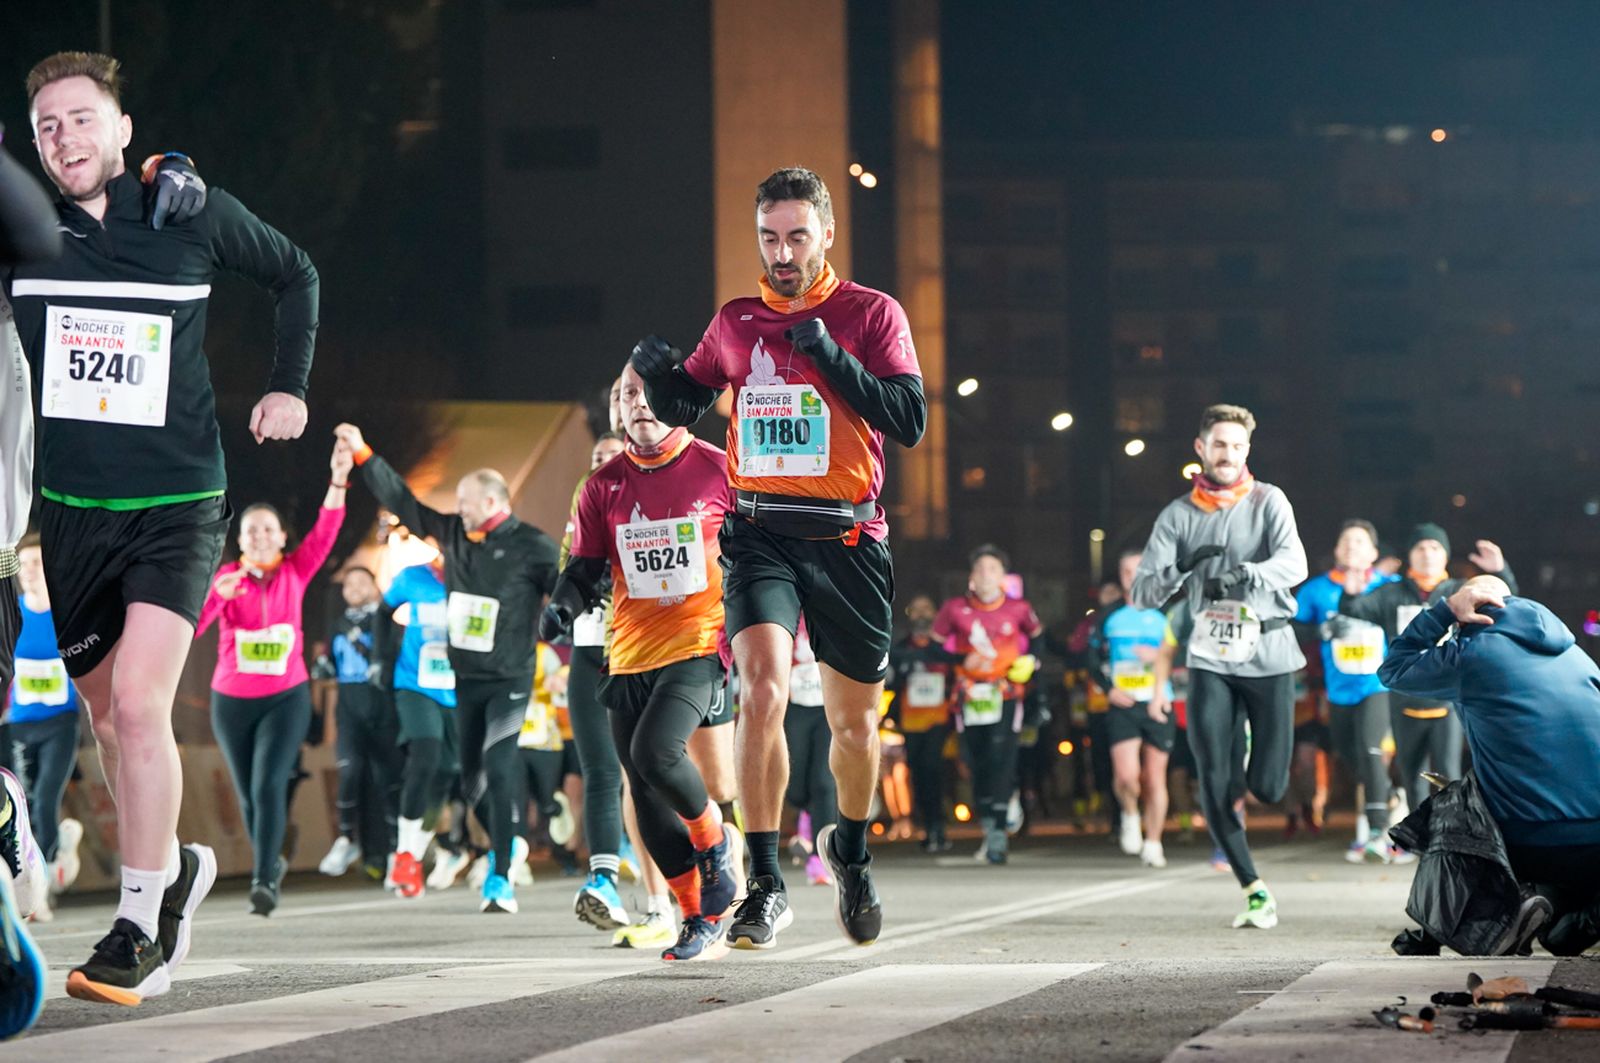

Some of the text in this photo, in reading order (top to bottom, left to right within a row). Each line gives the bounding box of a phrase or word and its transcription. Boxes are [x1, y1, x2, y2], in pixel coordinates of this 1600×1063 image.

[74, 322, 108, 334] NOCHE
[111, 325, 125, 336] DE
[61, 335, 82, 346] SAN
[69, 349, 146, 386] 5240
[754, 396, 781, 405] NOCHE
[782, 395, 792, 405] DE
[746, 407, 761, 417] SAN
[753, 418, 810, 446] 9180
[633, 530, 658, 539] NOCHE
[660, 528, 669, 537] DE
[626, 541, 642, 550] SAN
[634, 546, 689, 573] 5624
[1209, 620, 1243, 639] 2141
